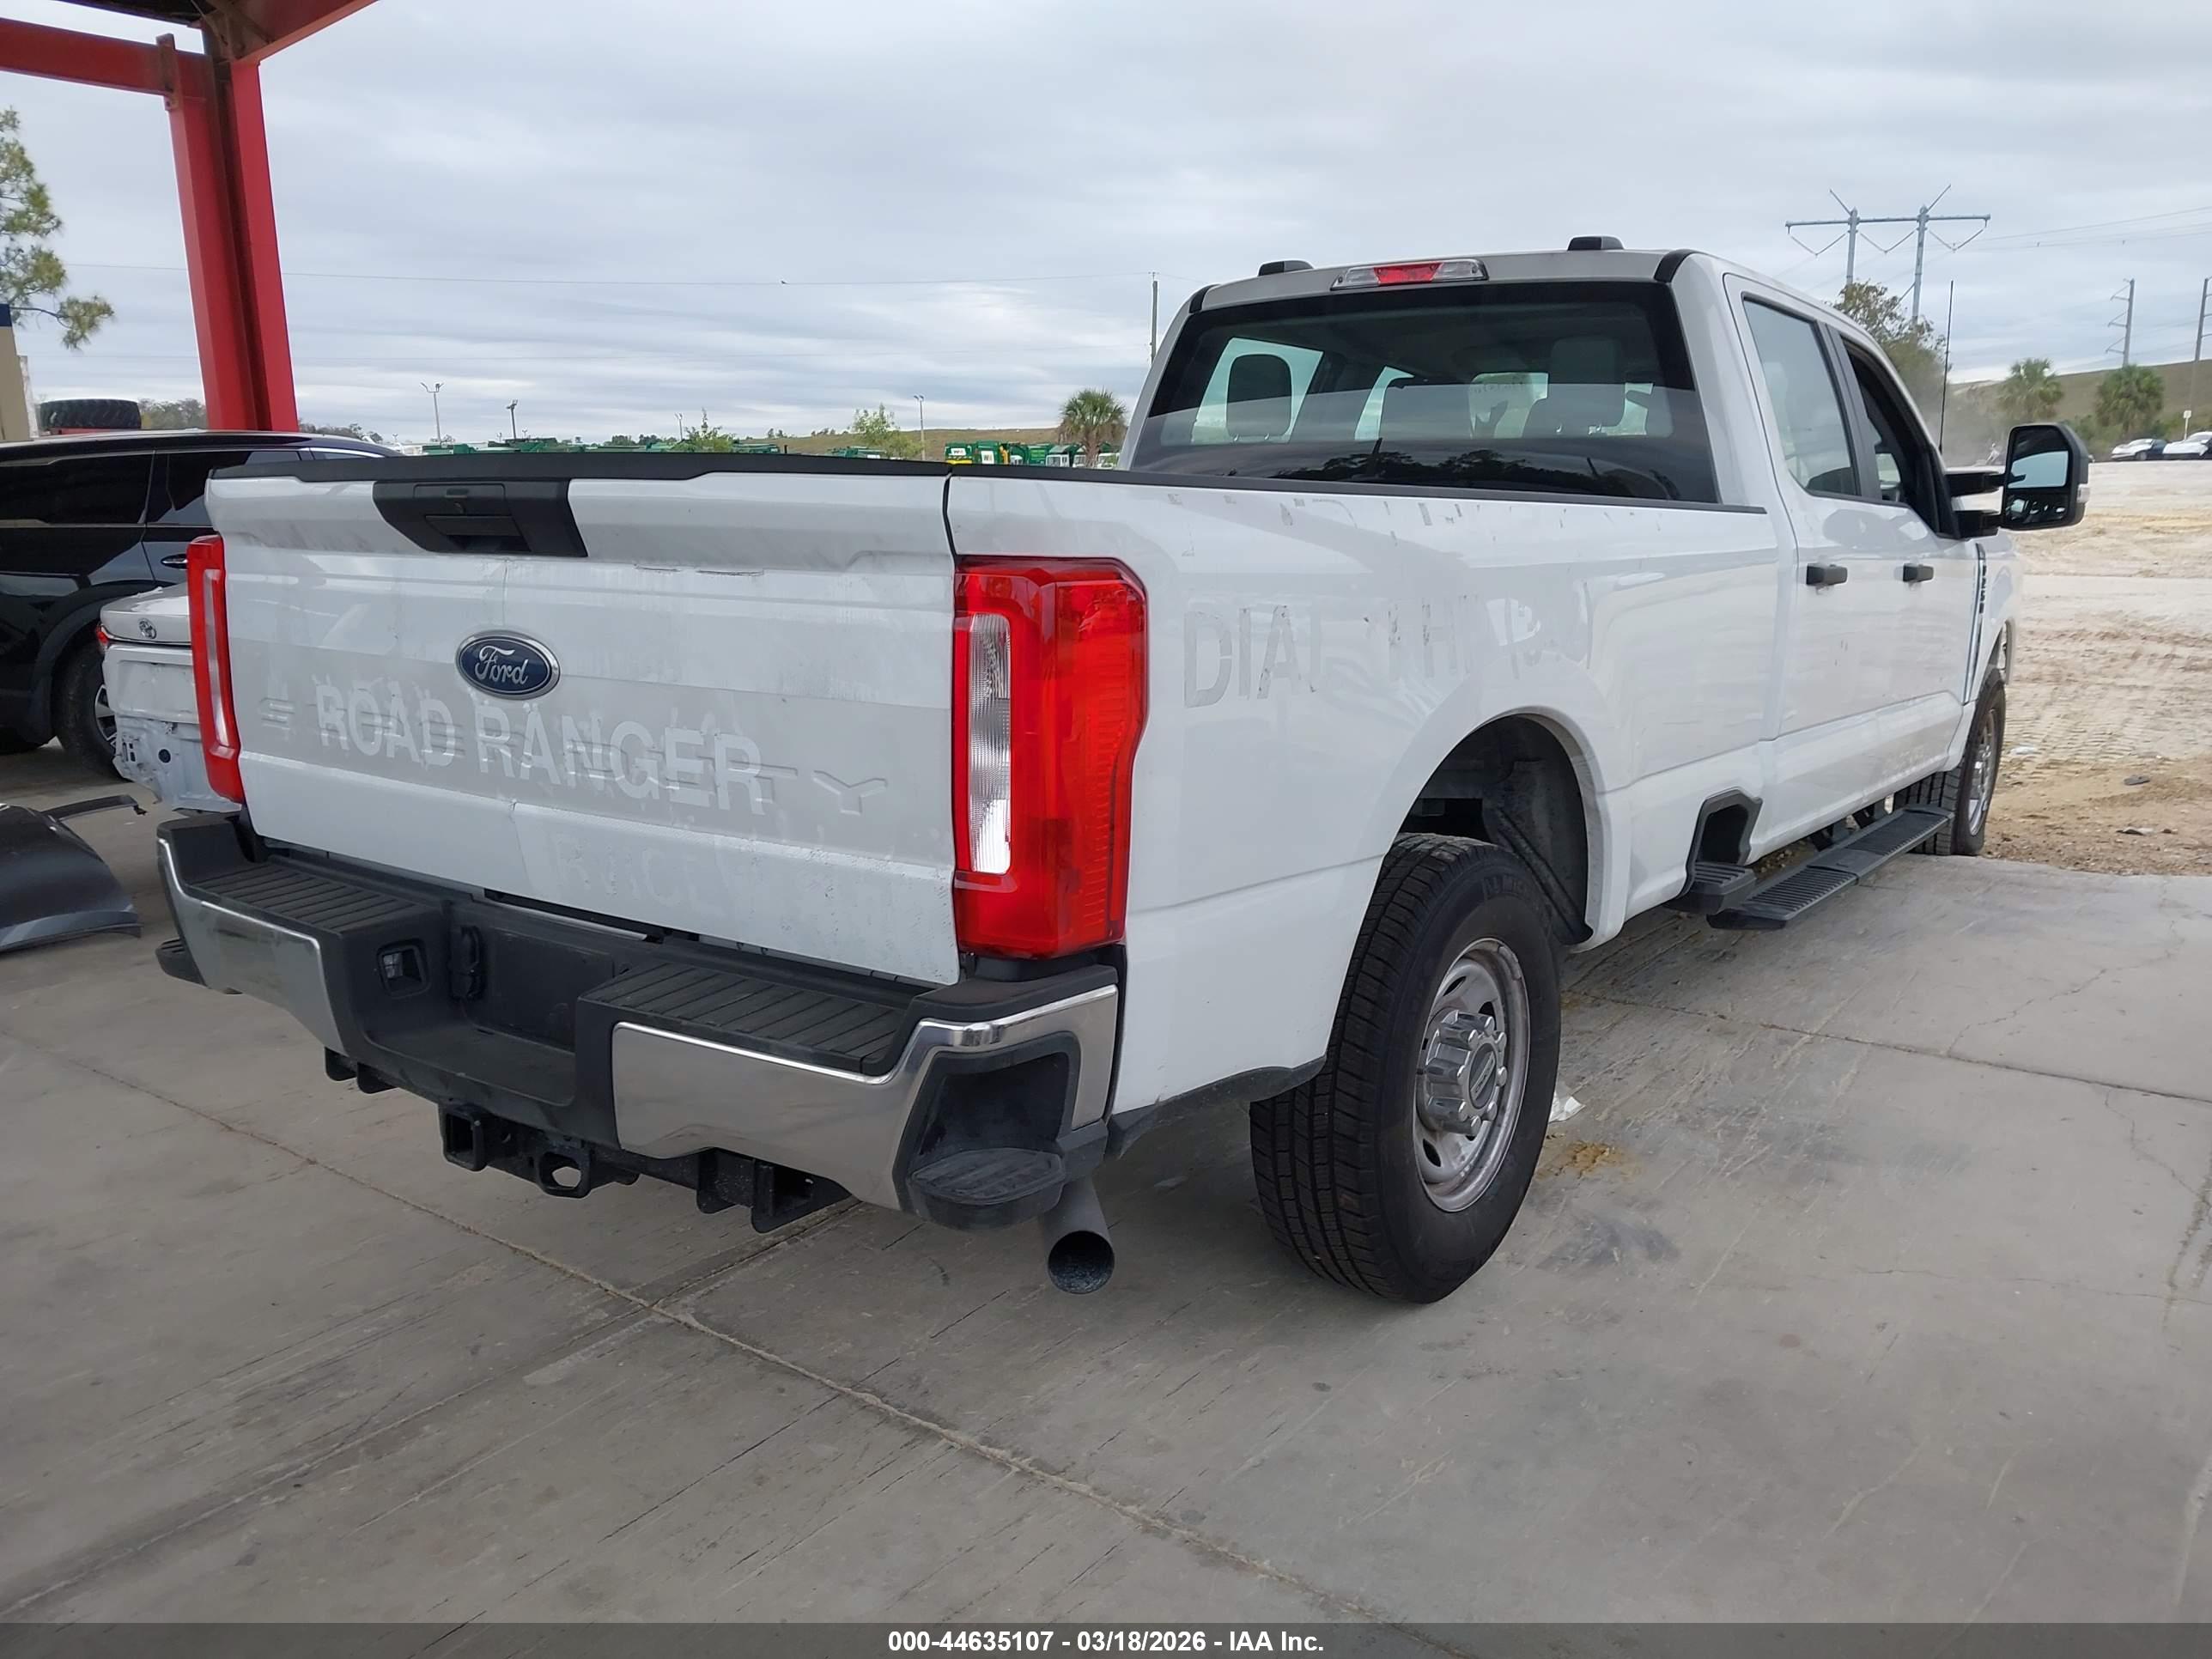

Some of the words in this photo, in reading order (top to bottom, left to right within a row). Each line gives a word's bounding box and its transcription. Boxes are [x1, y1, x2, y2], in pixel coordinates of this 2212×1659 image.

[475, 645, 529, 684] Ford
[315, 684, 457, 768] ROAD
[474, 704, 766, 816] RANGER
